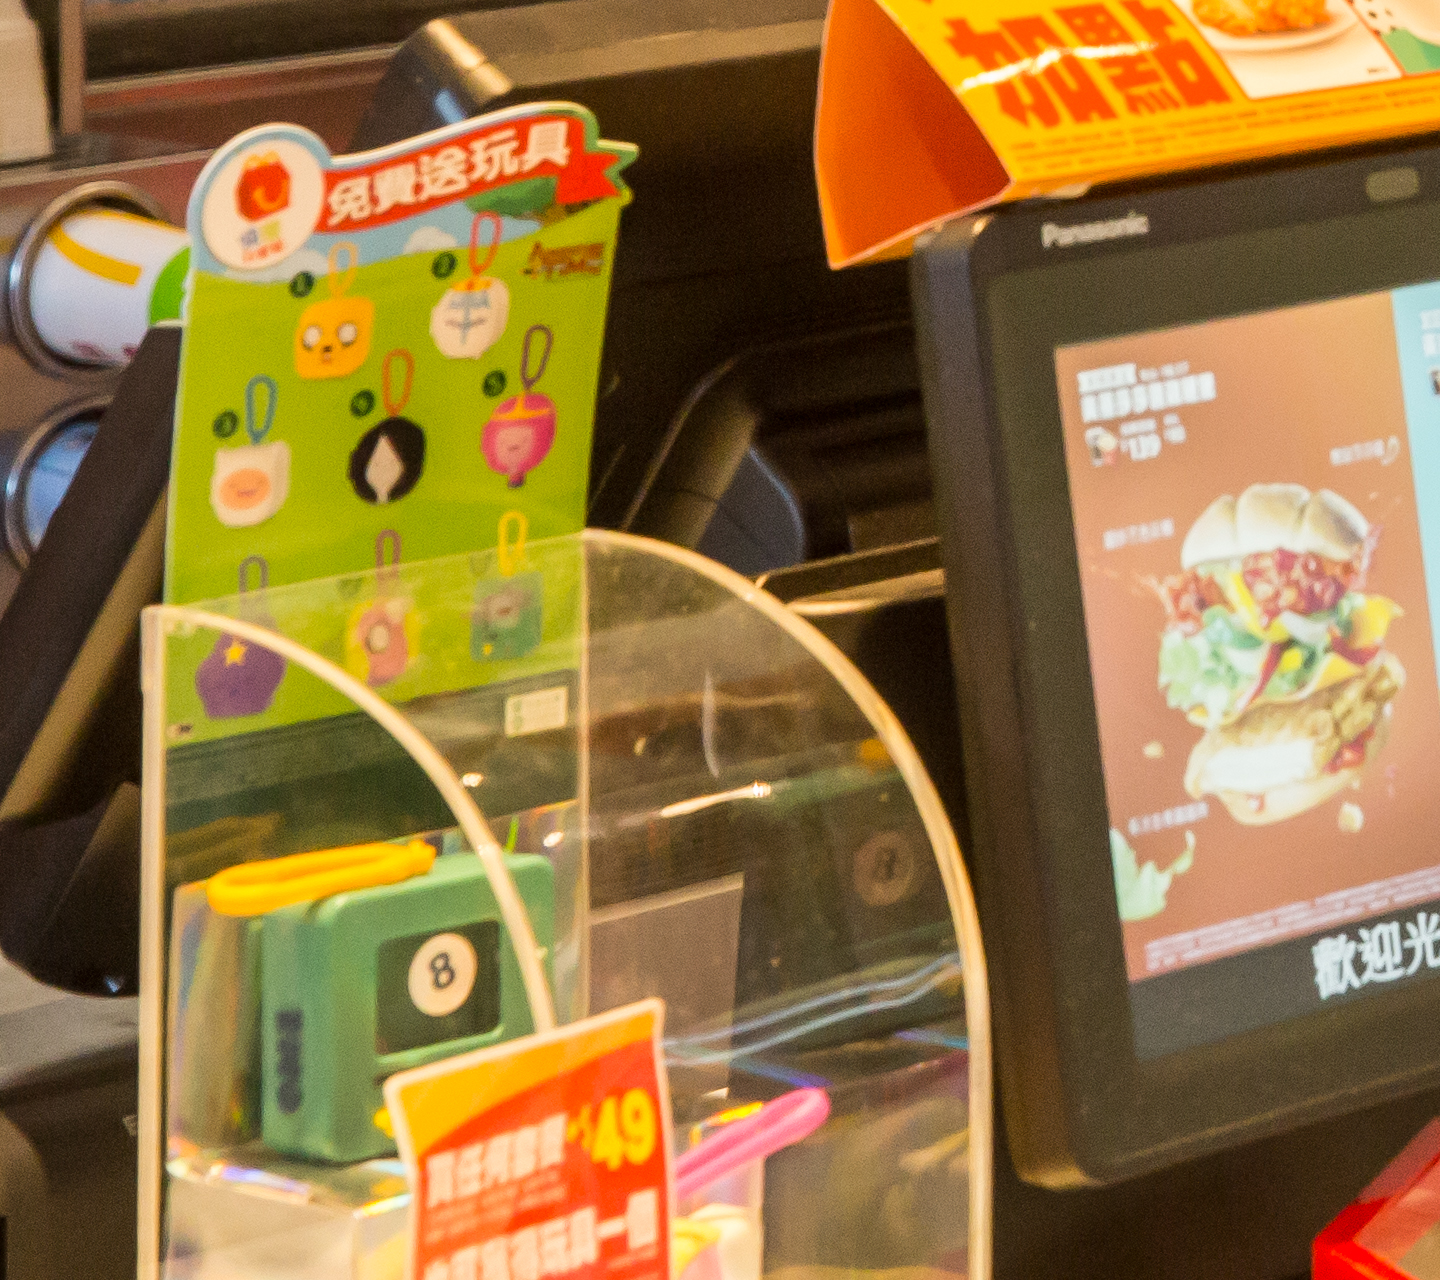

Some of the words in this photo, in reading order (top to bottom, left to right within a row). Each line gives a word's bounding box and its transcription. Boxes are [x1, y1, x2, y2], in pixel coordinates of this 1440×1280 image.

[327, 119, 570, 227] 免費送玩具
[1041, 210, 1150, 249] Panasonic
[430, 950, 455, 989] 8
